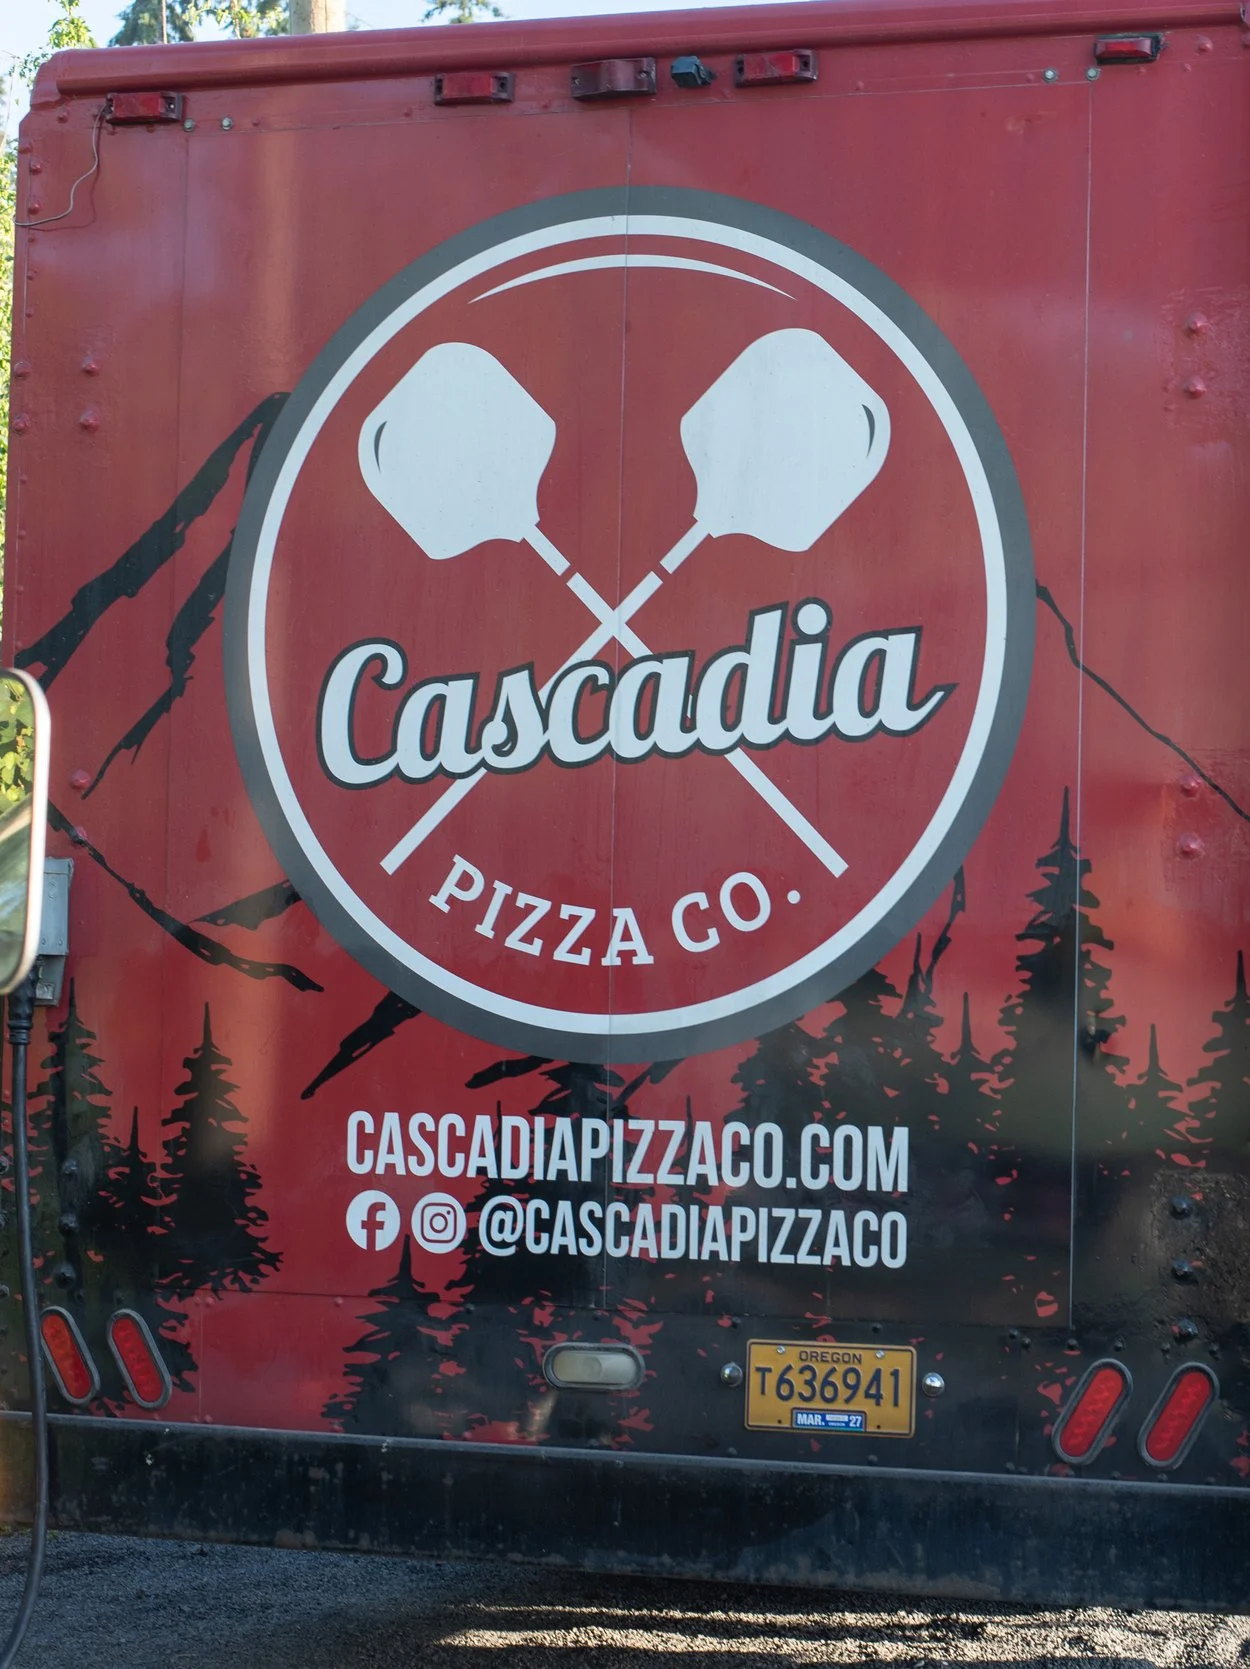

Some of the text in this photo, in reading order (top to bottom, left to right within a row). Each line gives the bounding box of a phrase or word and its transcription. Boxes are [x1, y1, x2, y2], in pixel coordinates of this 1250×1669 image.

[317, 597, 959, 790] Cascadia
[428, 854, 802, 967] PIZZA CO.
[346, 1109, 910, 1192] CASCADIAPIZZACO.COM
[478, 1194, 909, 1268] @CASCADIAPIZZACO
[755, 1364, 900, 1407] T636941
[799, 1350, 863, 1364] OREGON
[796, 1413, 825, 1426] MAR.
[849, 1415, 862, 1427] 27
